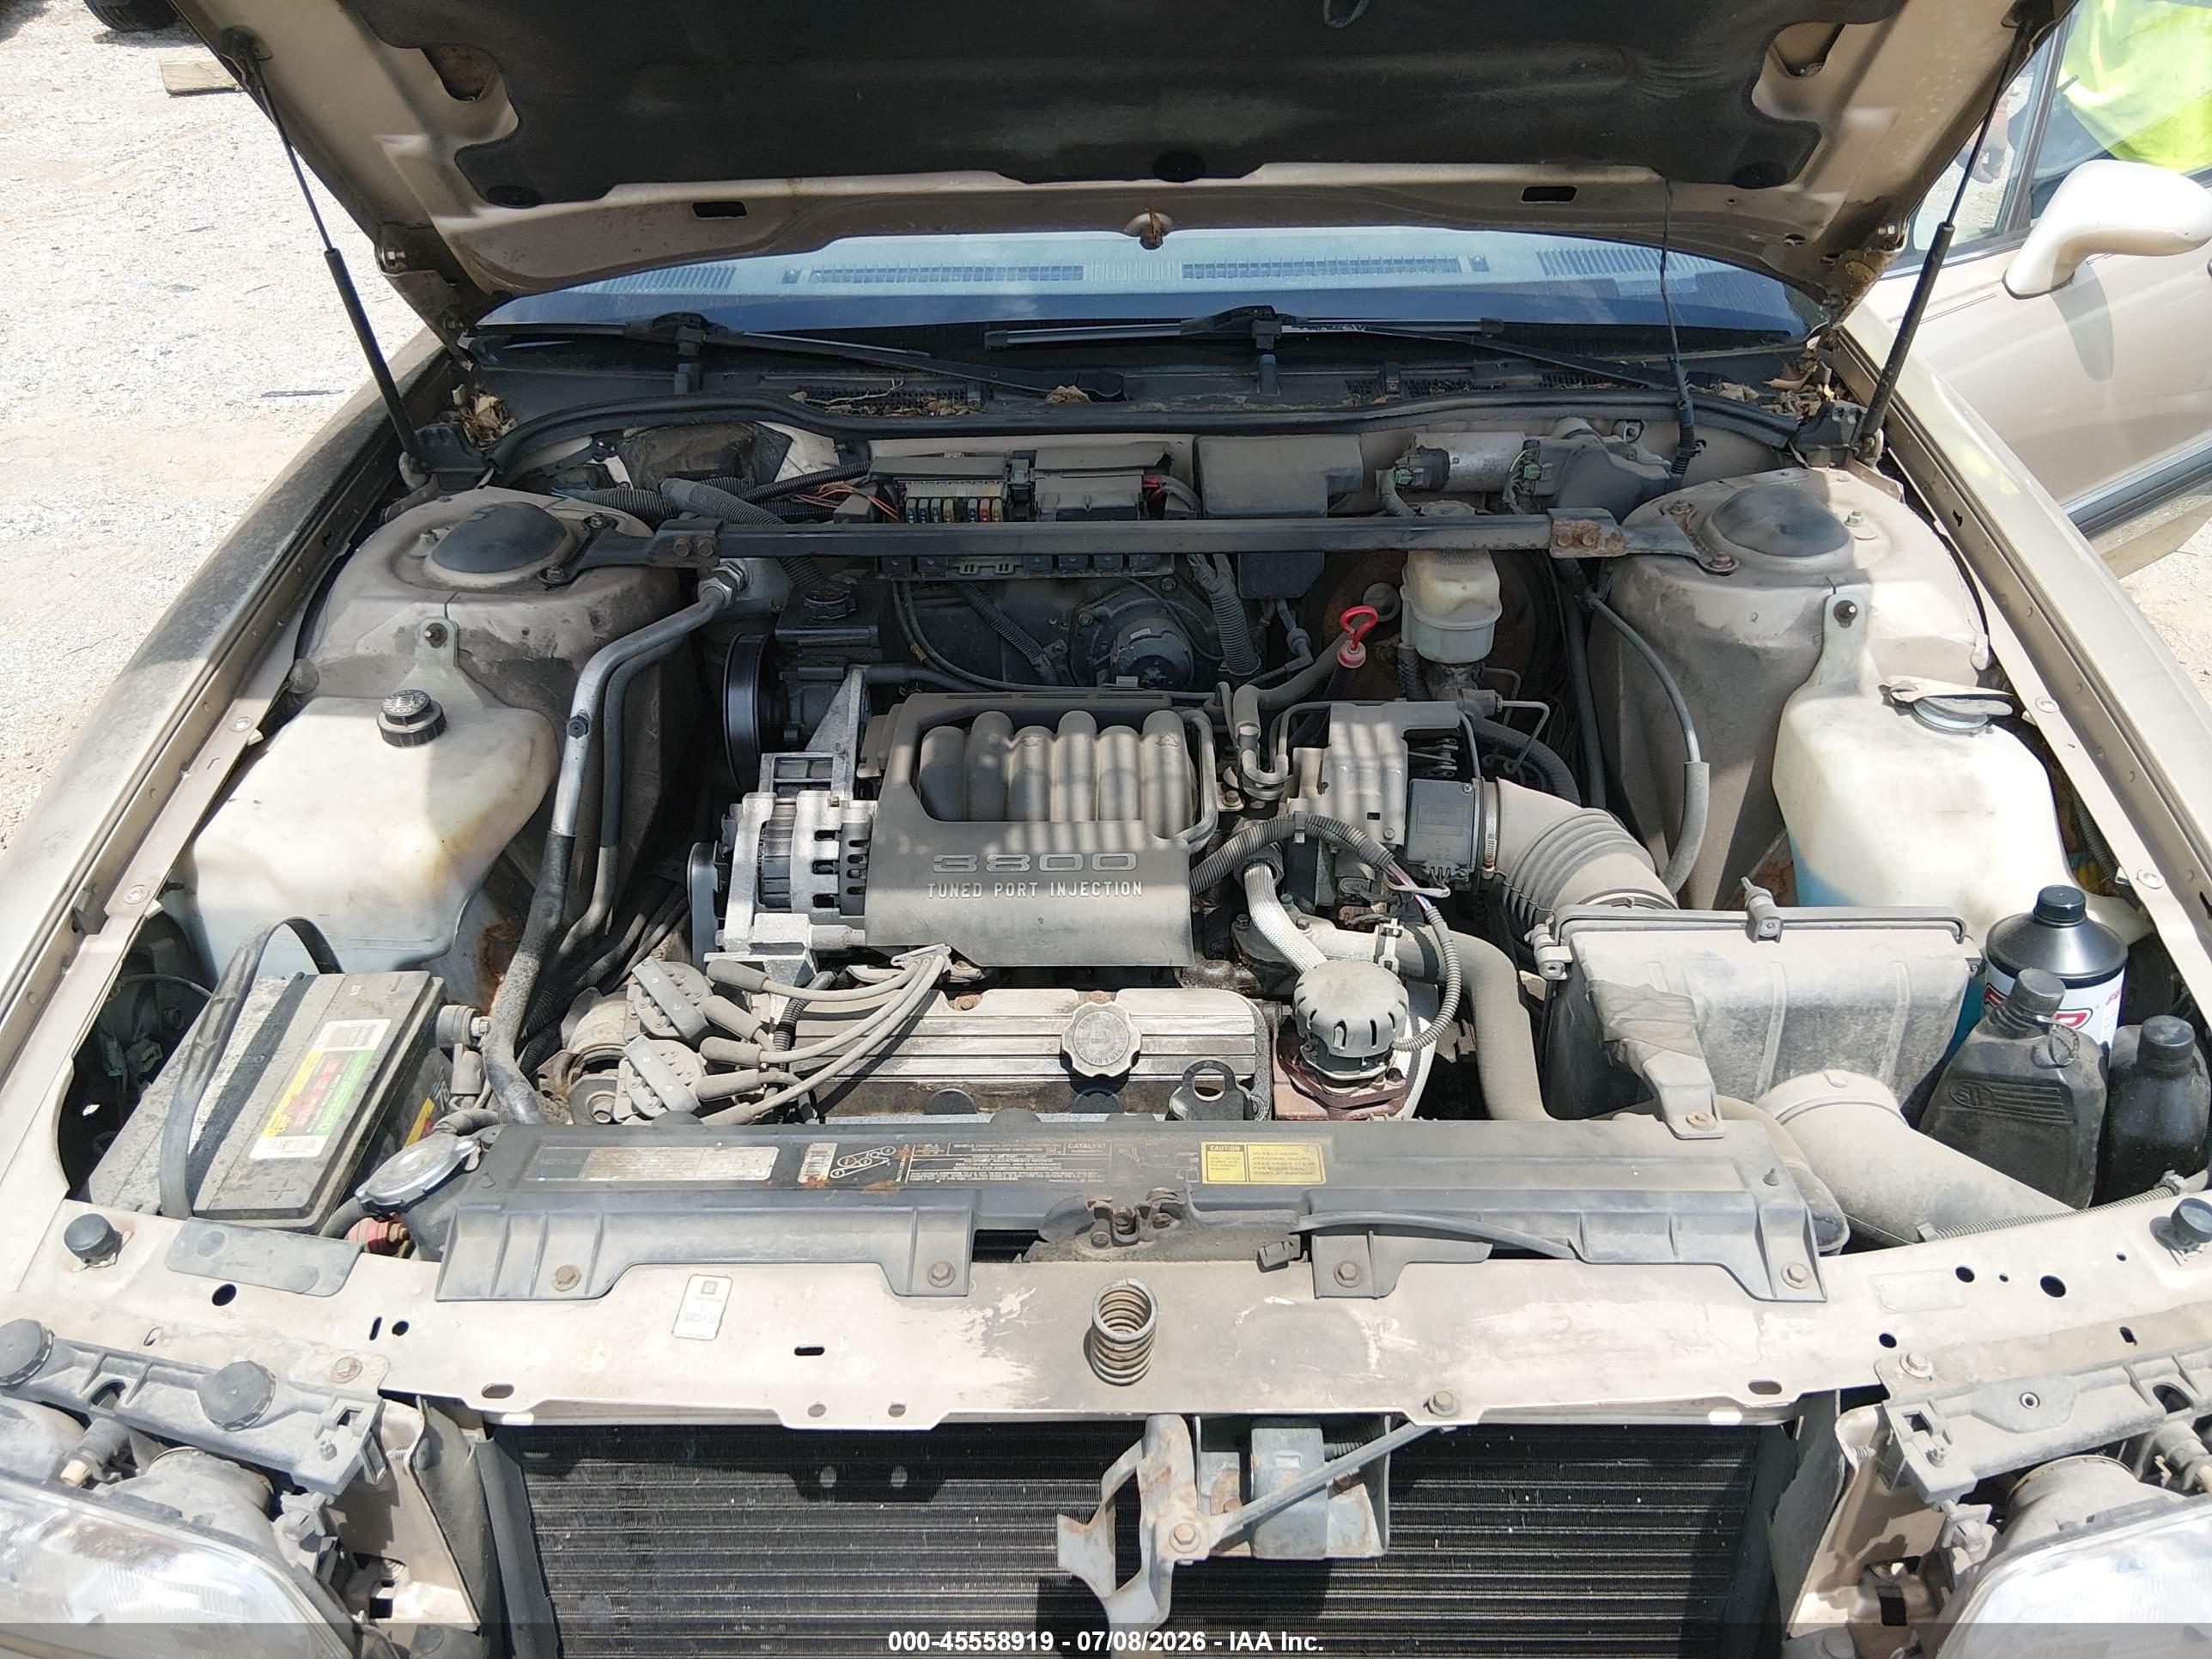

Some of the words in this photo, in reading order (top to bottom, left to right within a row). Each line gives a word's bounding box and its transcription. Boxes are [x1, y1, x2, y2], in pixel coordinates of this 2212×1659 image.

[933, 852, 1139, 872] 3800
[927, 882, 983, 899] TUNED
[994, 881, 1039, 898] PORT
[1049, 880, 1144, 897] INJECTION
